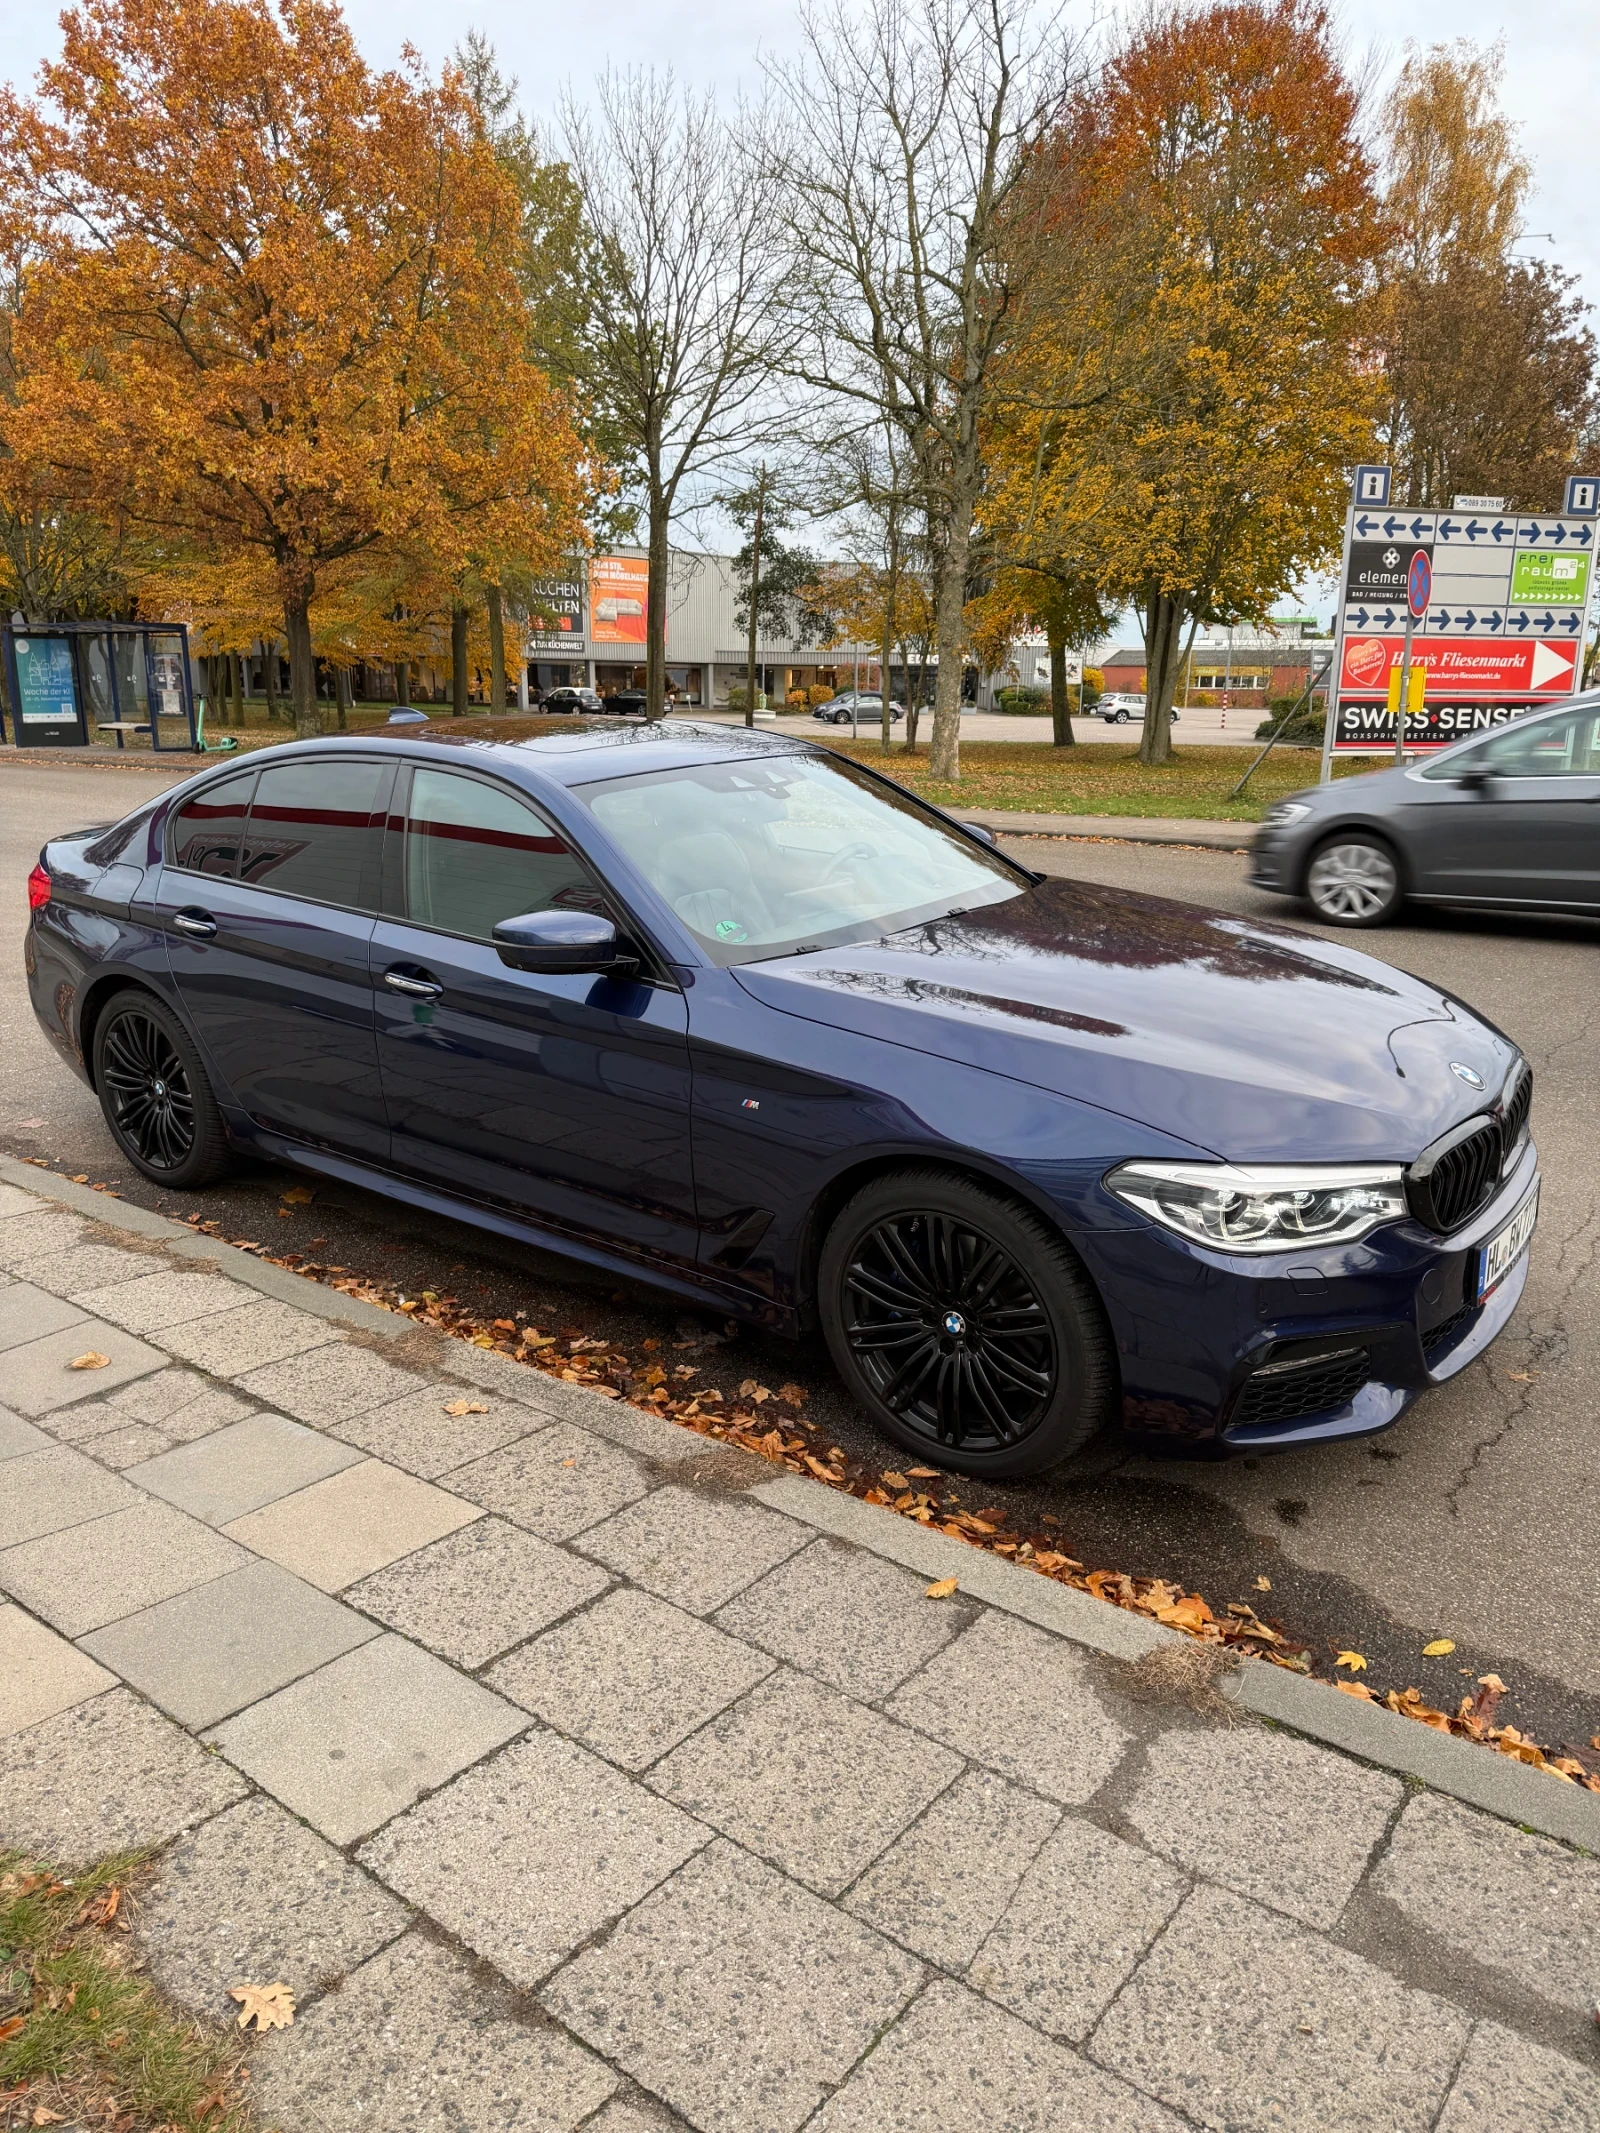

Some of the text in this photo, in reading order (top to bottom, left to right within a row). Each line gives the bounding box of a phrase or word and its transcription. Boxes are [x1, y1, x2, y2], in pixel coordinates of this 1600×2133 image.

[1359, 570, 1408, 584] elemen
[1440, 652, 1526, 668] Fliesenmarkt
[23, 688, 49, 696] Woche
[1343, 707, 1430, 729] SWISS
[720, 922, 733, 932] 4
